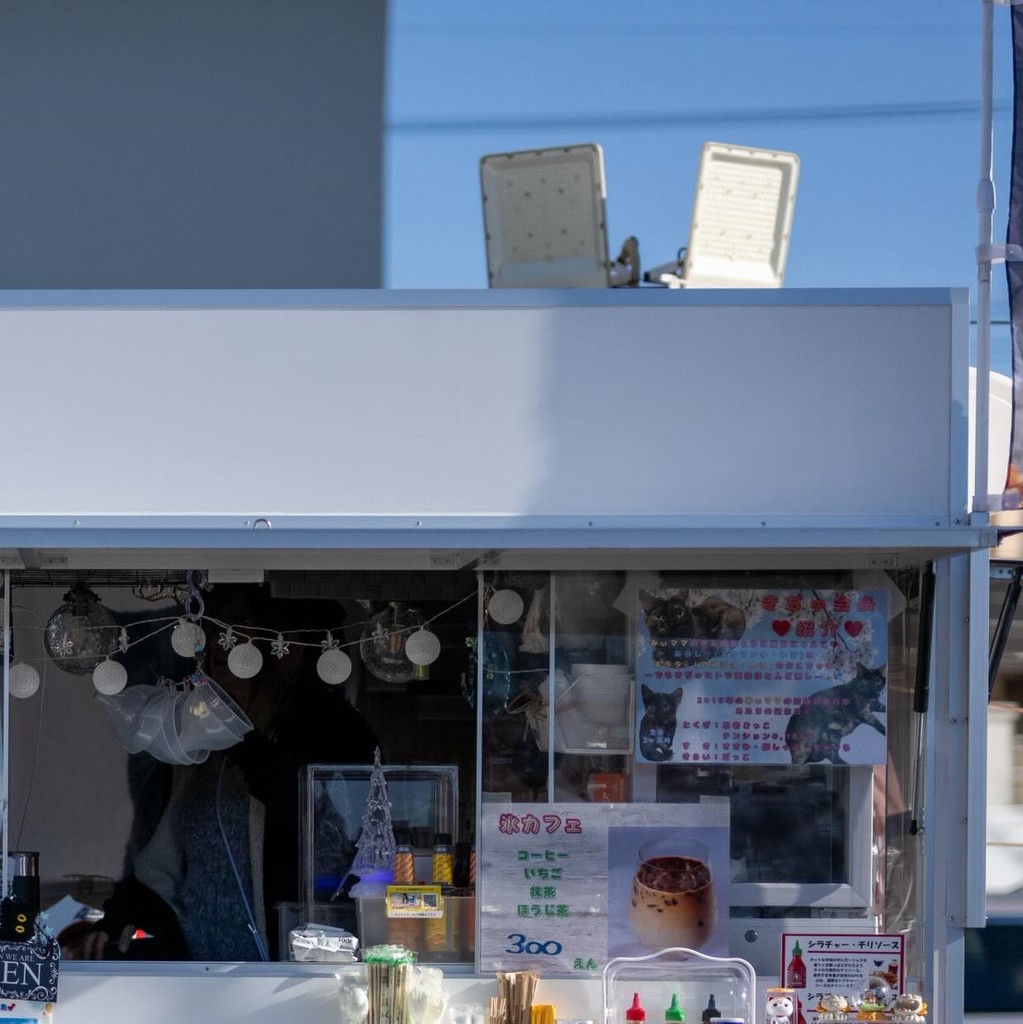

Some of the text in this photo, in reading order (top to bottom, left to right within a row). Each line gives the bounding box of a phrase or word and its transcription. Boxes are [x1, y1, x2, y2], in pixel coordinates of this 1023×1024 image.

[499, 813, 582, 834] 氷カフェ
[518, 850, 569, 861] コーヒー
[524, 868, 562, 878] いちご
[530, 887, 556, 899] 抹茶
[517, 904, 569, 917] ほうじ茶
[505, 934, 562, 955] 300
[5, 953, 16, 961] WE
[18, 954, 35, 962] ARE
[574, 958, 597, 969] えん
